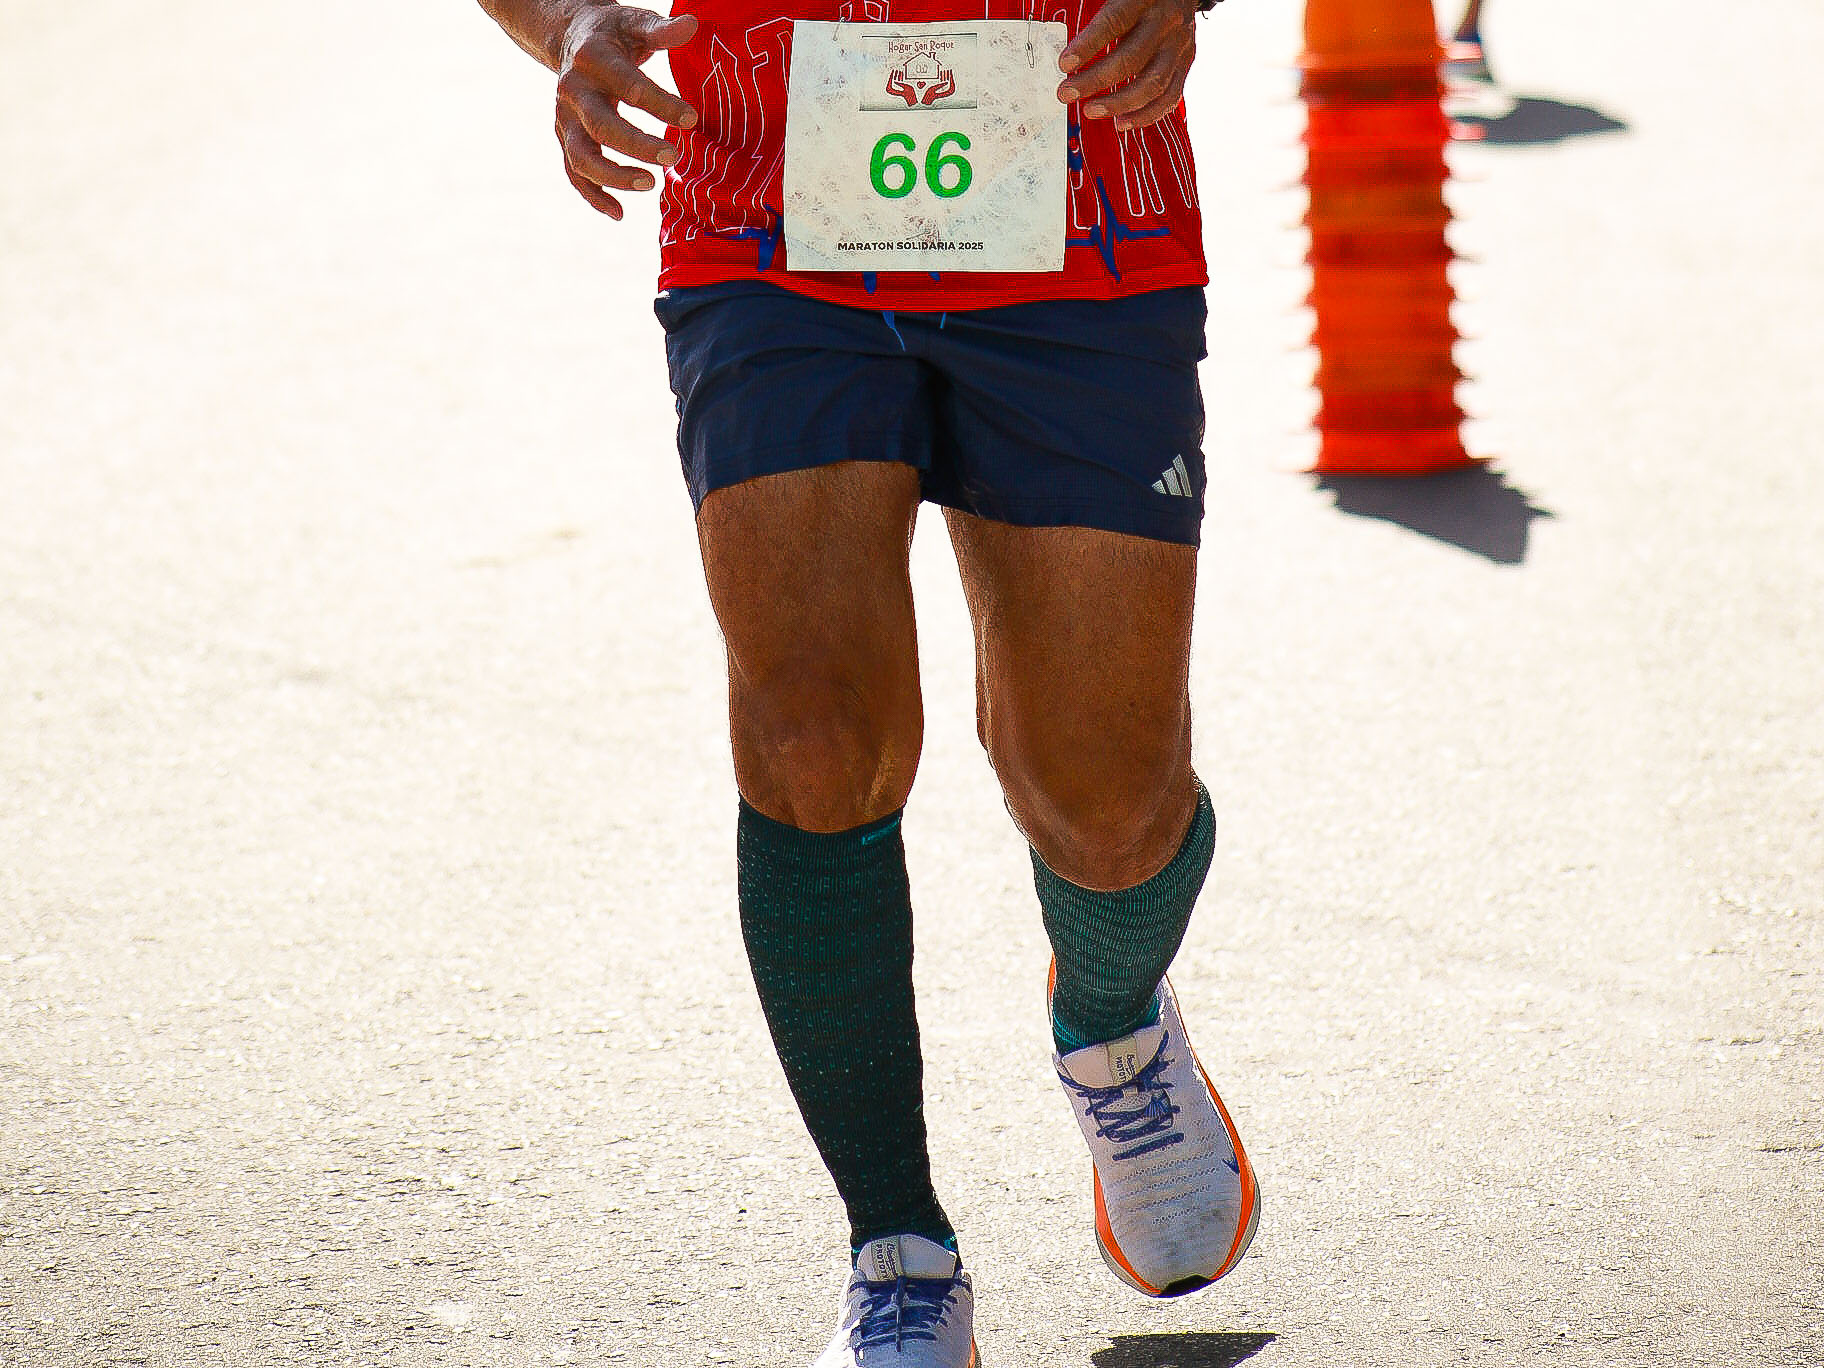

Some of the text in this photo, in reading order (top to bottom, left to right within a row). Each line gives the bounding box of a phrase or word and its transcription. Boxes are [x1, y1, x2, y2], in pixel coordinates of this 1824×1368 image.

[888, 40, 954, 53] Hogar San Roque
[869, 131, 973, 199] 66
[837, 241, 984, 251] MARATON SOLIDARIA 2025
